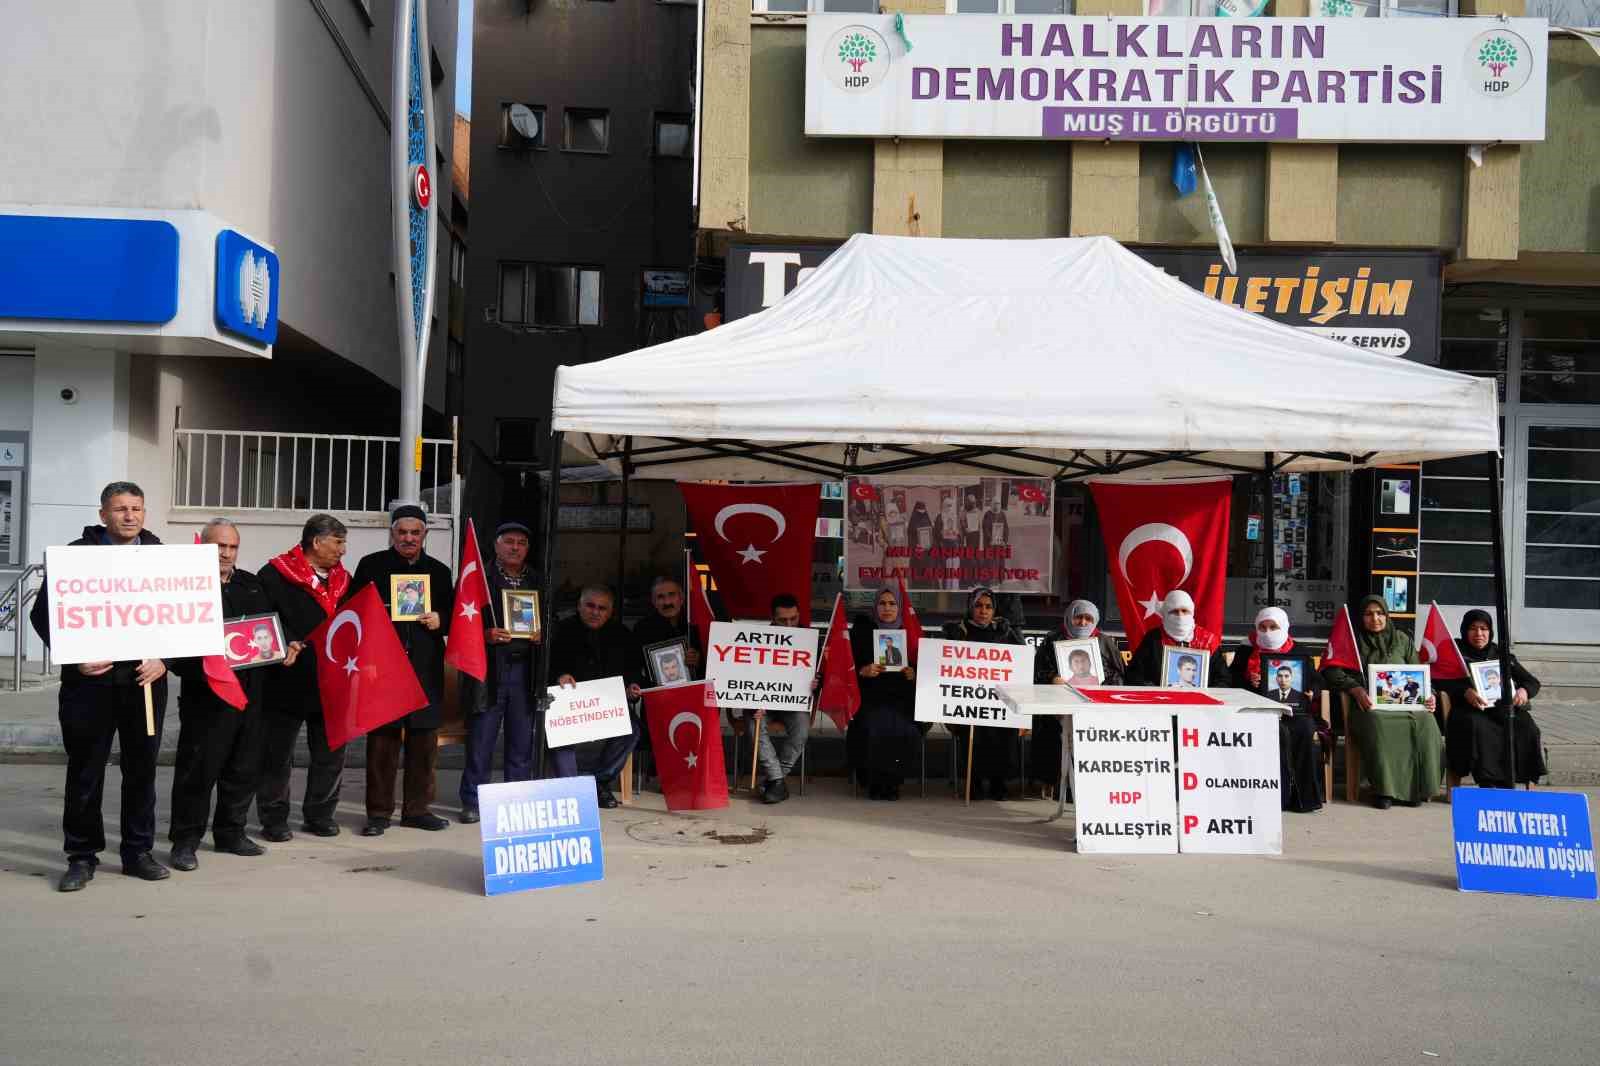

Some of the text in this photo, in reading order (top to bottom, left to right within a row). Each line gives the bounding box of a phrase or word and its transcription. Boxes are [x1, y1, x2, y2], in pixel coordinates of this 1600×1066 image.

[1002, 24, 1325, 58] HALKLARIN
[845, 76, 870, 88] HDP
[912, 64, 1443, 104] DEMOKRATİK PARTİSİ
[1484, 81, 1510, 92] HDP
[1064, 111, 1277, 135] MUŞ İL ÖRGÜTÜ
[1203, 264, 1413, 325] İLETİŞİM
[1351, 333, 1407, 349] SERVİS
[56, 575, 213, 598] ÇOCUKLARIMIZI
[56, 601, 215, 630] İSTİYORUZ
[734, 631, 793, 646] ARTIK
[713, 644, 812, 667] YETER
[942, 645, 1013, 662] EVLADA
[940, 664, 1013, 681] HASRET
[727, 679, 793, 692] BIRAKIN
[569, 697, 601, 711] EVLAT
[942, 703, 1007, 721] LANET!
[549, 705, 625, 729] NÖBETİNDEYİZ
[1075, 727, 1171, 742] TÜRK-KÜRT
[1182, 728, 1253, 748] H ALKI
[1078, 758, 1171, 776] KARDEŞTİR
[1183, 772, 1280, 790] D OLANDIRAN
[1109, 791, 1142, 805] HDP
[496, 797, 581, 834] ANNELER
[1183, 815, 1253, 835] P ARTİ
[1478, 809, 1518, 834] ARTIK
[1518, 812, 1560, 837] YETER
[1082, 820, 1173, 839] KALLEŞTİR
[494, 833, 593, 876] DİRENİYOR
[1455, 841, 1595, 879] YAKAMIZDAN DÜŞÜN
